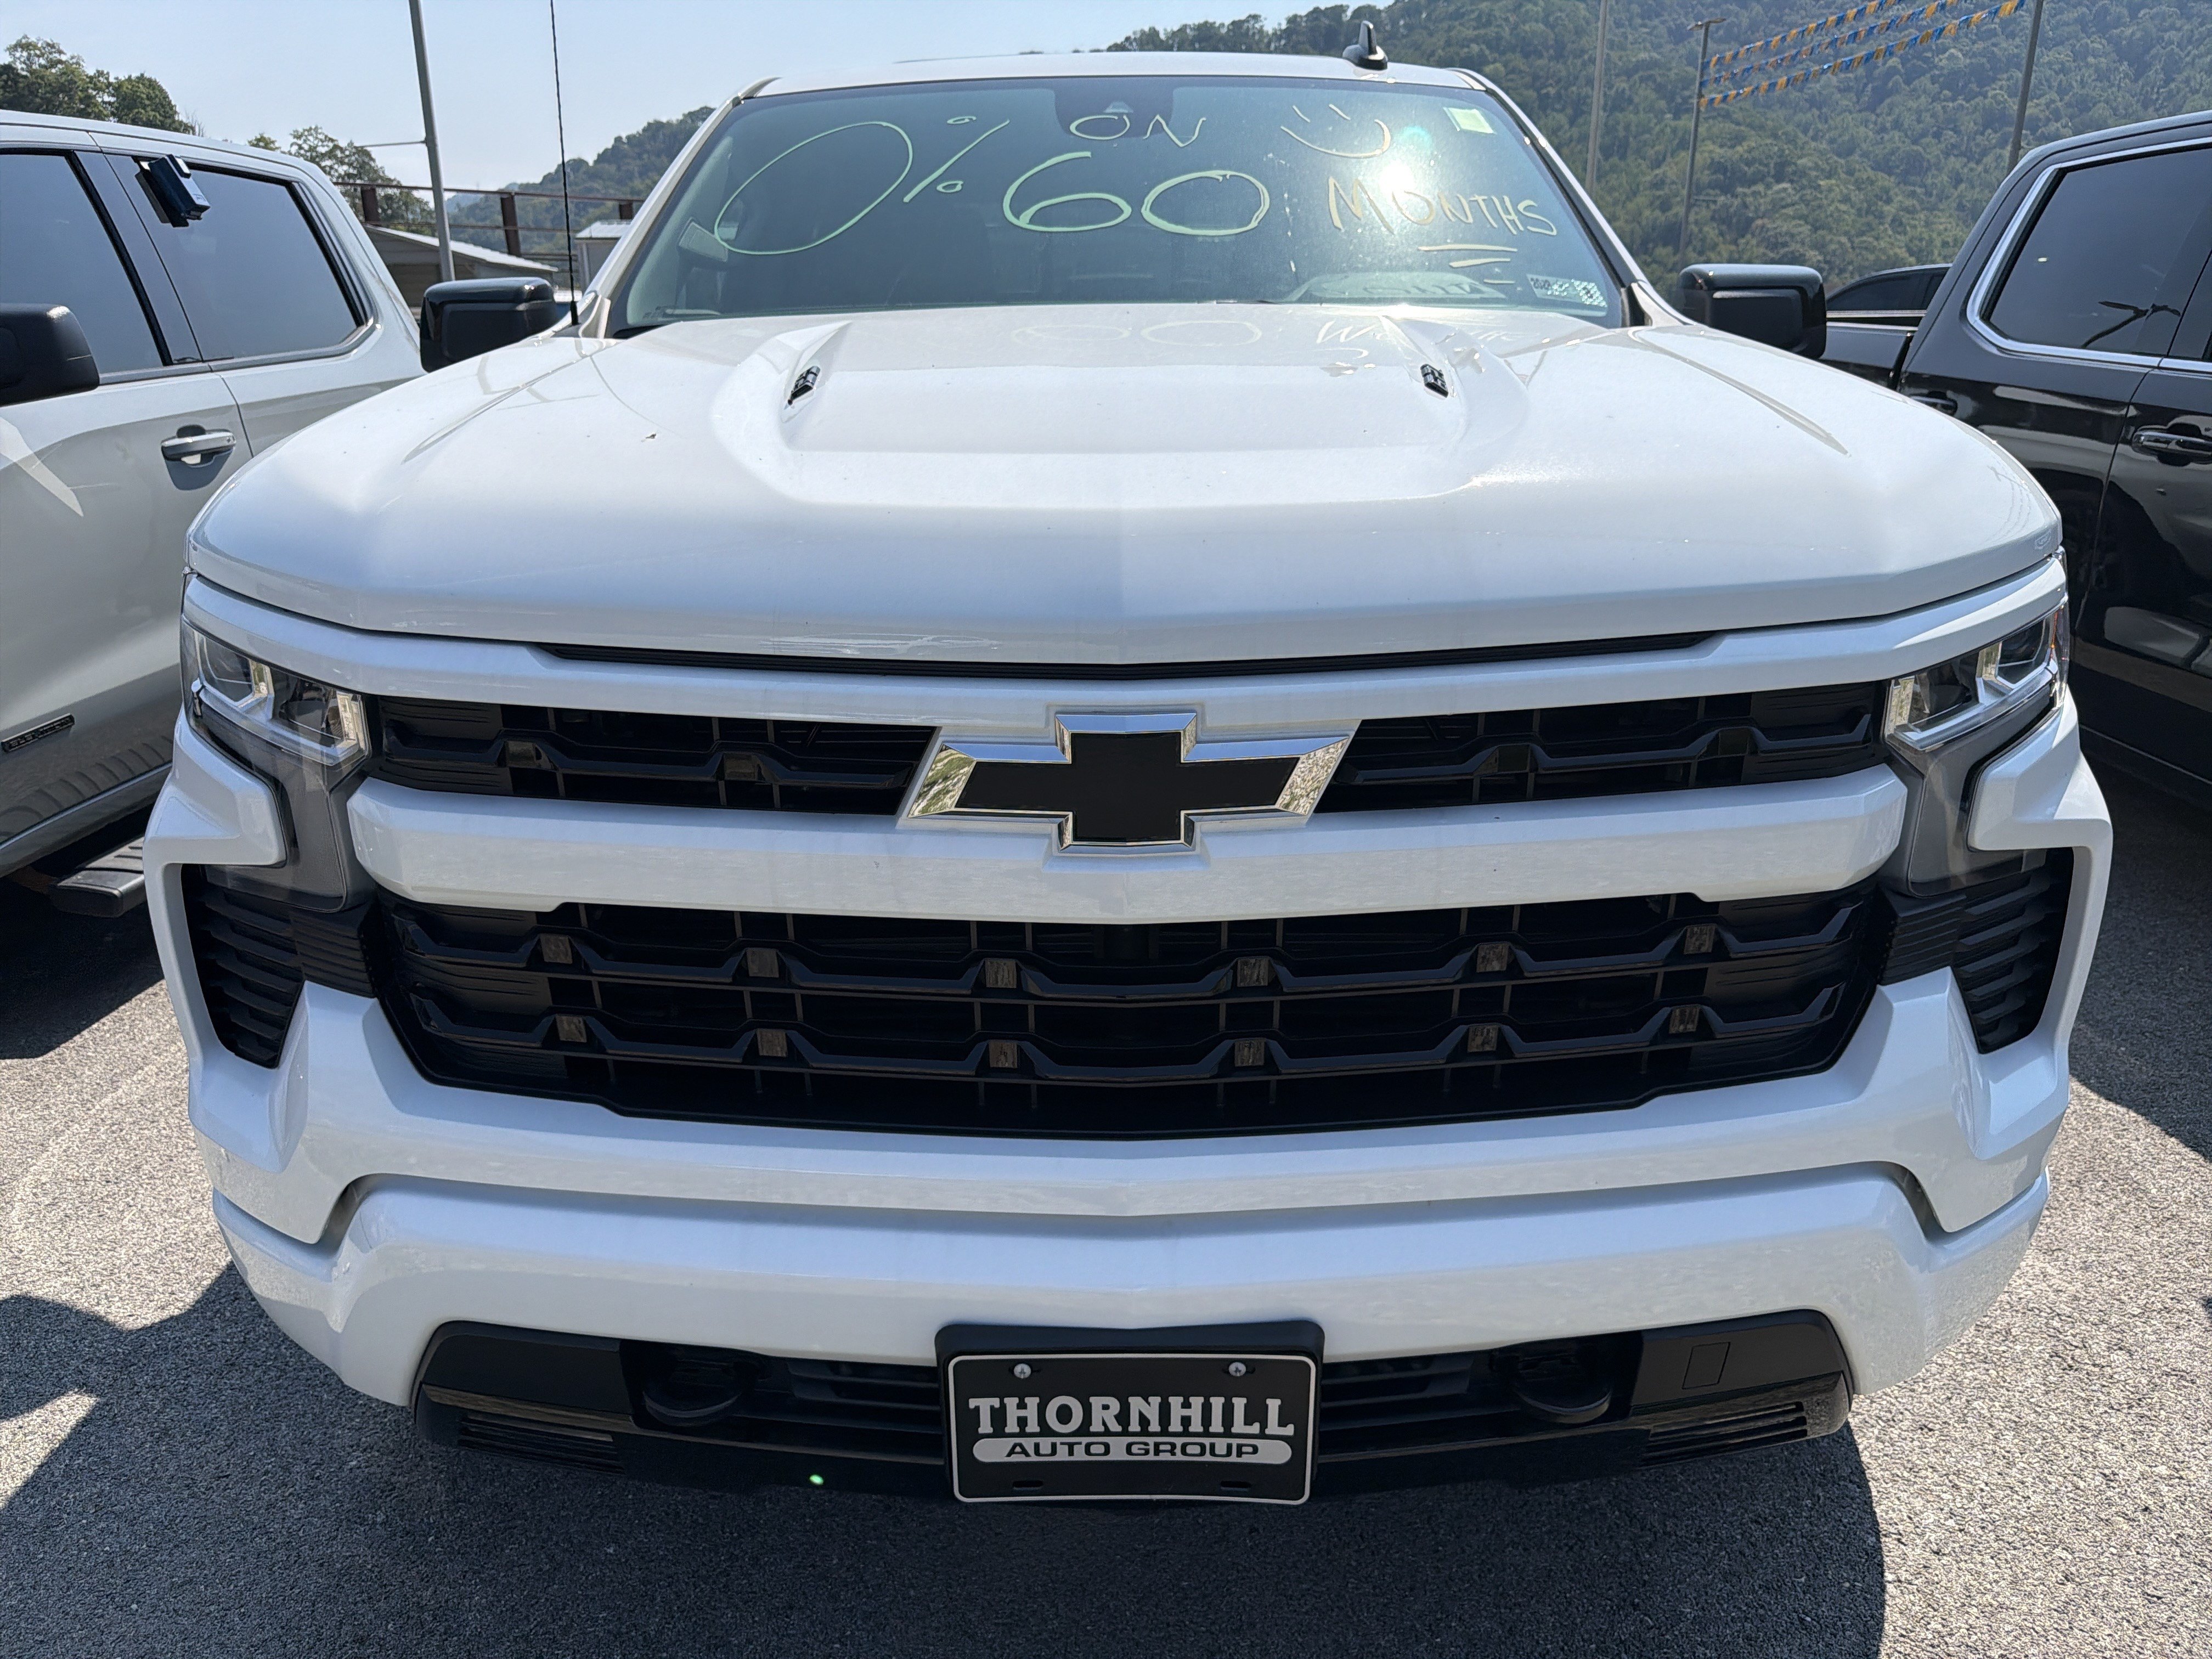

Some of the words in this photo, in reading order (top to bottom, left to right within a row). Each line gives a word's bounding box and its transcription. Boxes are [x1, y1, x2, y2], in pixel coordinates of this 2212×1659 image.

[1069, 114, 1206, 148] ON
[1003, 151, 1270, 236] 60
[1328, 176, 1558, 236] MONTHS
[968, 1395, 1295, 1436] THORNHILL
[1004, 1441, 1111, 1458] AUTO
[1125, 1441, 1260, 1459] GROUP
